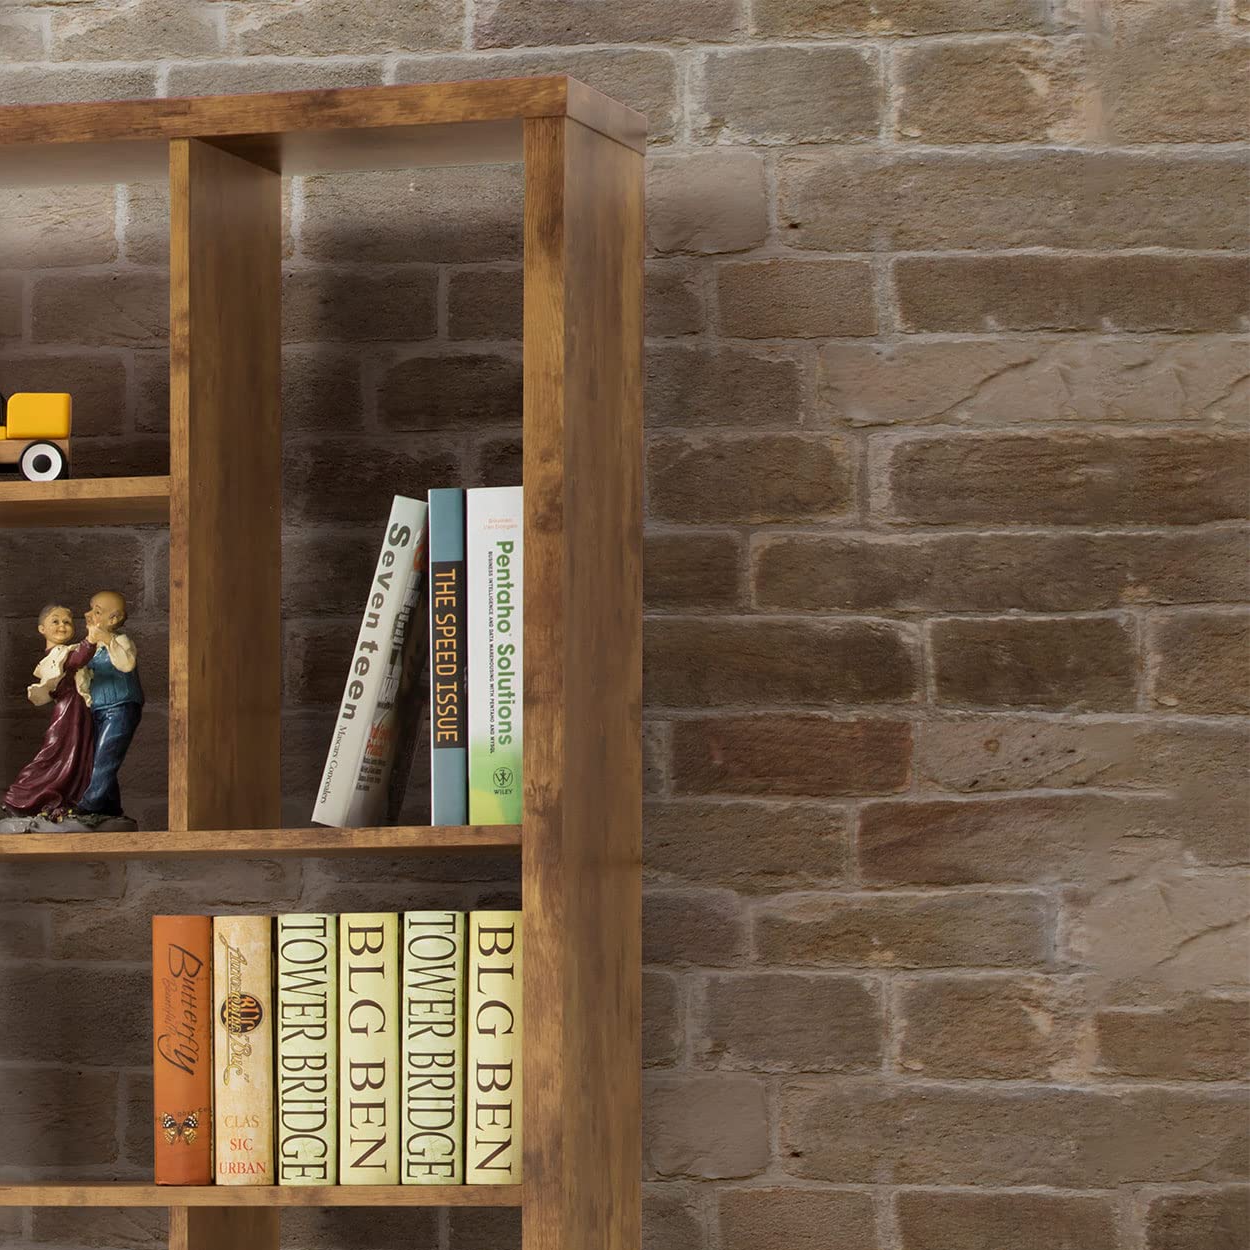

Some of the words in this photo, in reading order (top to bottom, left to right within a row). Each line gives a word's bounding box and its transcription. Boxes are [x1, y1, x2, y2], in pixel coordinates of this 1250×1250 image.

[435, 568, 456, 608] THE
[435, 614, 457, 674] SPEED
[437, 682, 459, 743] ISSUE
[497, 643, 516, 746] Solutions
[158, 943, 204, 1076] Butterfly
[280, 916, 329, 1044] TOWER
[347, 921, 387, 1037] BLG
[407, 912, 457, 1040] TOWER
[475, 922, 515, 1039] BLG
[219, 1161, 266, 1174] URBAN
[223, 1114, 260, 1128] CLAS
[229, 1138, 254, 1151] SIC
[280, 1052, 329, 1181] BRIDGE
[348, 1057, 388, 1173] BEN
[406, 1050, 456, 1179] BRIDGE
[474, 1058, 514, 1175] BEN
